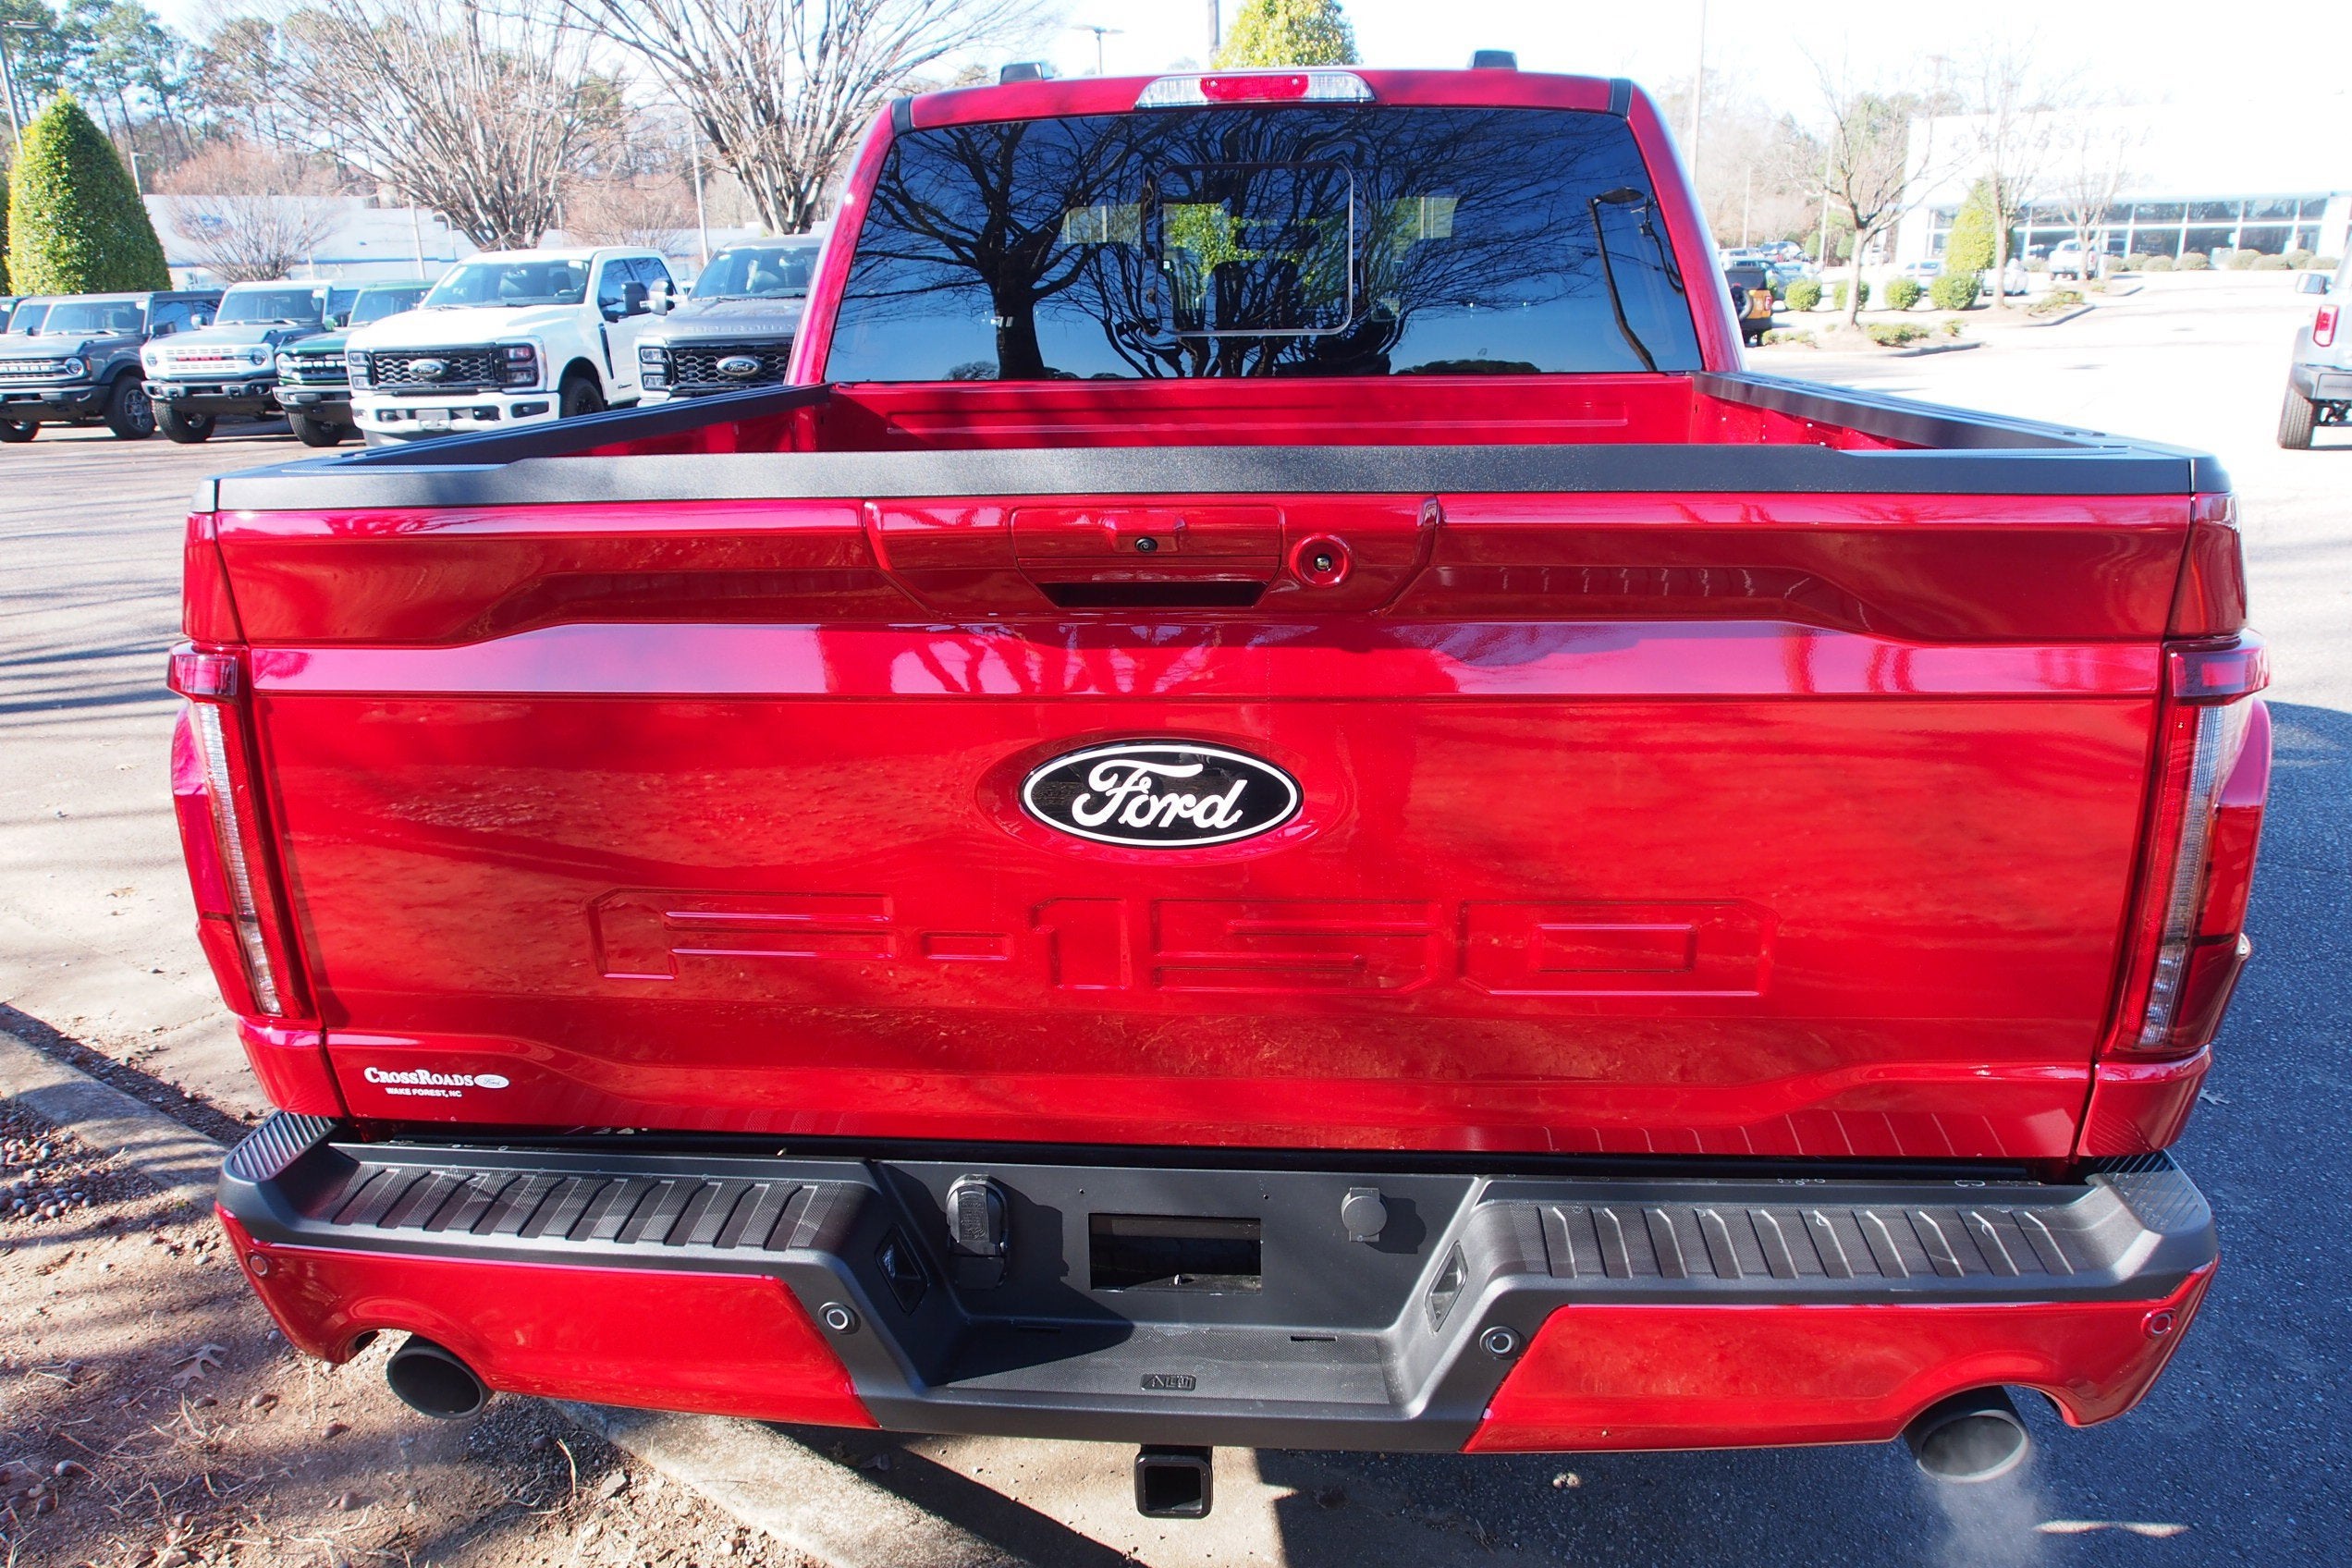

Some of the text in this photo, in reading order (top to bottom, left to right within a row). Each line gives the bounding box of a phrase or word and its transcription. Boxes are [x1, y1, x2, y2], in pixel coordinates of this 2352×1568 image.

[1072, 758, 1248, 829] Ford
[588, 888, 1781, 995] F-150
[385, 1087, 411, 1096] WAKE
[412, 1088, 449, 1097] FOREST,
